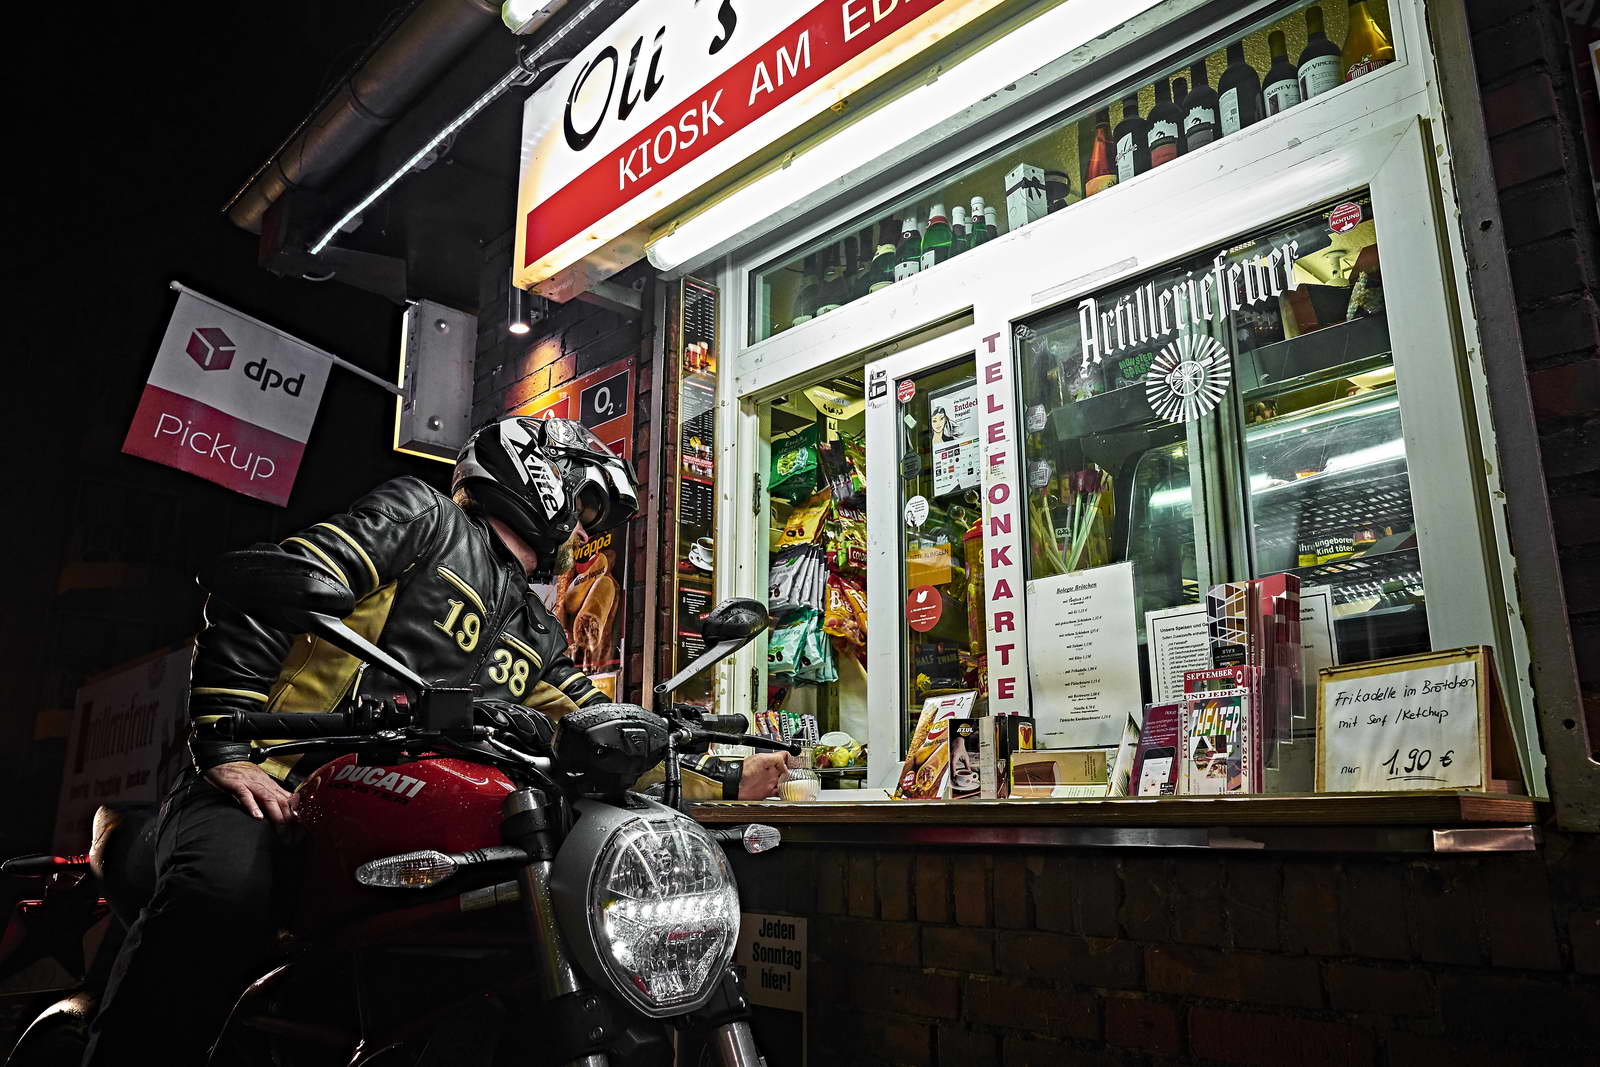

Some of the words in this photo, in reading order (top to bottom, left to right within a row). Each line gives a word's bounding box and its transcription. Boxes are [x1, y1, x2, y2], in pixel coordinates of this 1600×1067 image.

[563, 25, 666, 151] Oli
[617, 89, 725, 191] KIOSK
[748, 31, 812, 107] AM
[1332, 213, 1360, 226] ACHTUNG
[1077, 239, 1299, 371] Artilleriefeuer
[244, 358, 305, 397] dpd
[153, 413, 276, 480] Pickup
[982, 331, 1020, 716] TELEFONKARTE
[573, 533, 614, 561] wrappa
[1316, 546, 1335, 556] Kind
[433, 599, 481, 653] 19
[488, 649, 530, 697] 38
[1186, 668, 1232, 681] SEPTEMBER
[1335, 687, 1396, 706] Frikadelle
[1404, 685, 1416, 697] im
[1422, 675, 1474, 695] Brötchen
[1189, 705, 1241, 743] THEATER
[1339, 716, 1358, 729] mit
[1367, 714, 1387, 726] Senf
[1341, 766, 1360, 774] nur
[1382, 749, 1431, 775] 1,90
[1440, 750, 1454, 767] €
[333, 764, 428, 798] DUCATI
[759, 918, 796, 940] Jeden
[752, 942, 802, 970] Sonntag
[761, 968, 791, 992] hier!
